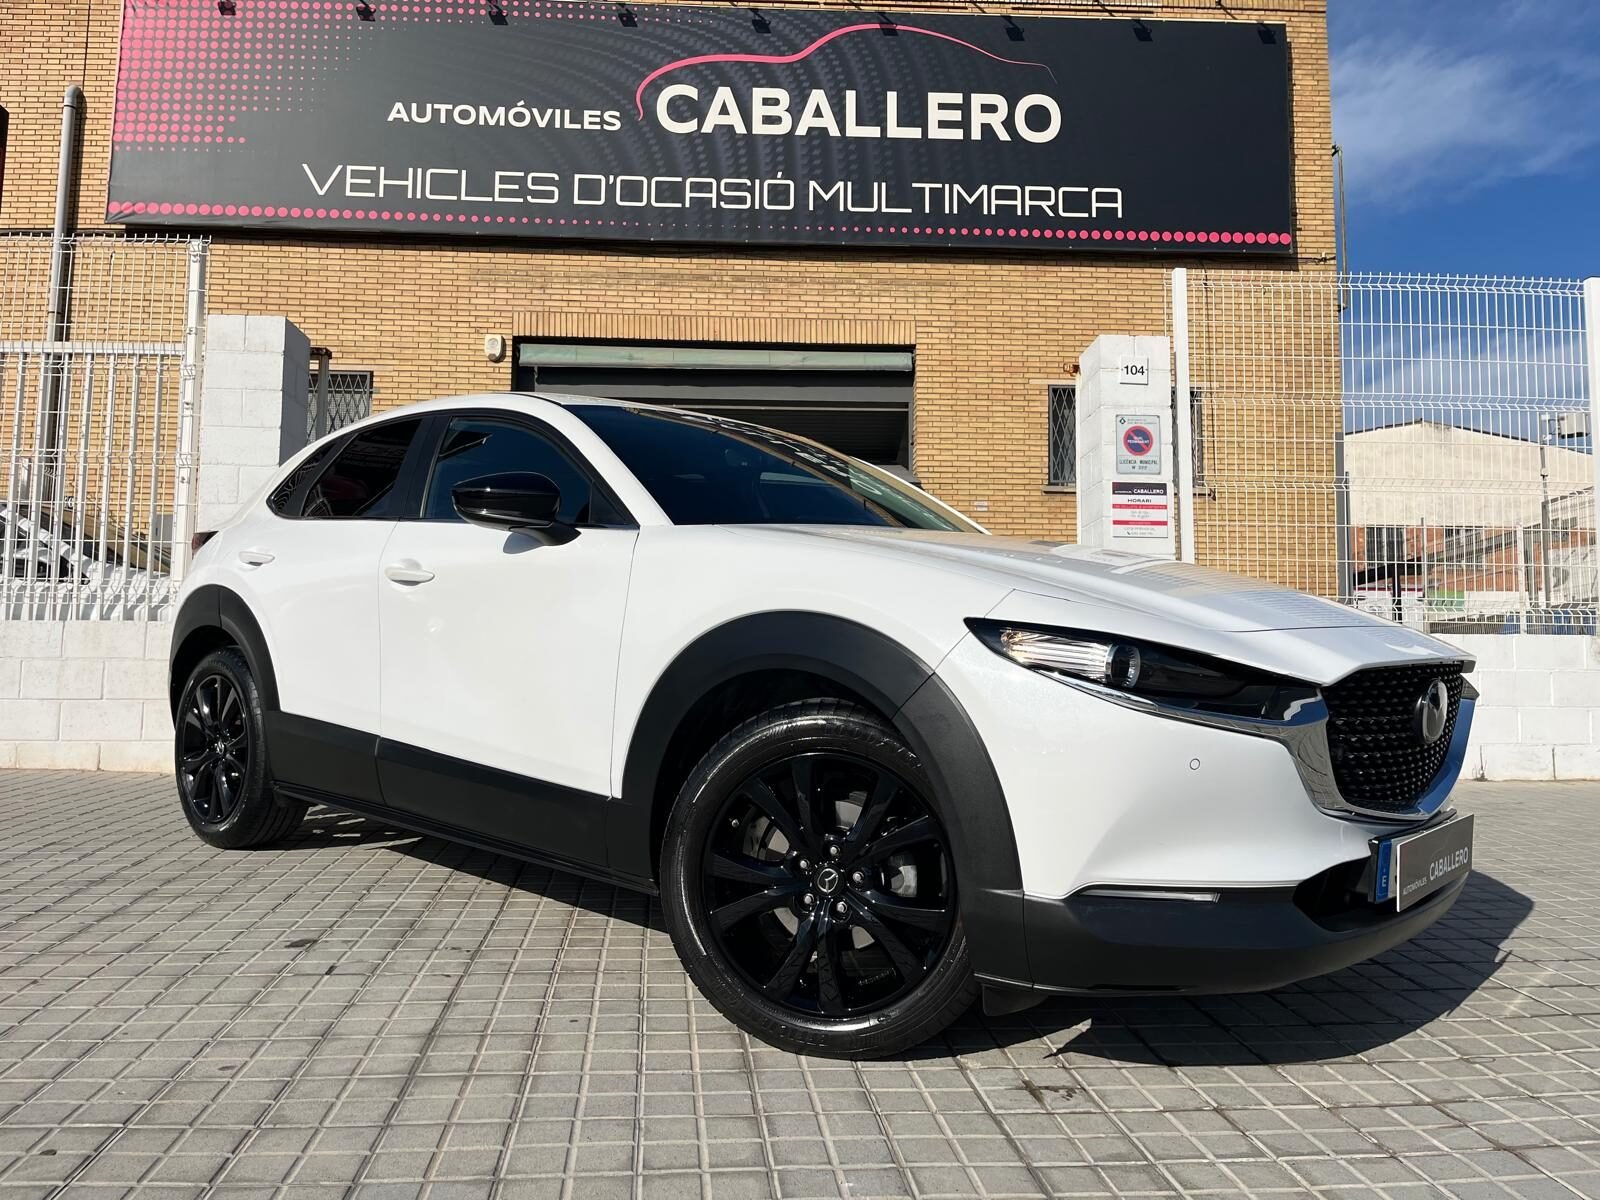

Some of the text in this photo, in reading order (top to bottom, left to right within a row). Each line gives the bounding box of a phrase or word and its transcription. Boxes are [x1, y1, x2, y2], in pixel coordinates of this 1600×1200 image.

[387, 84, 1062, 144] AUTOMÓVILES CABALLERO
[302, 163, 559, 205] VEHICLES
[809, 180, 1123, 219] MULTIMARCA
[1123, 364, 1145, 376] 104
[1381, 875, 1387, 887] E
[1429, 847, 1469, 881] CABALLERO
